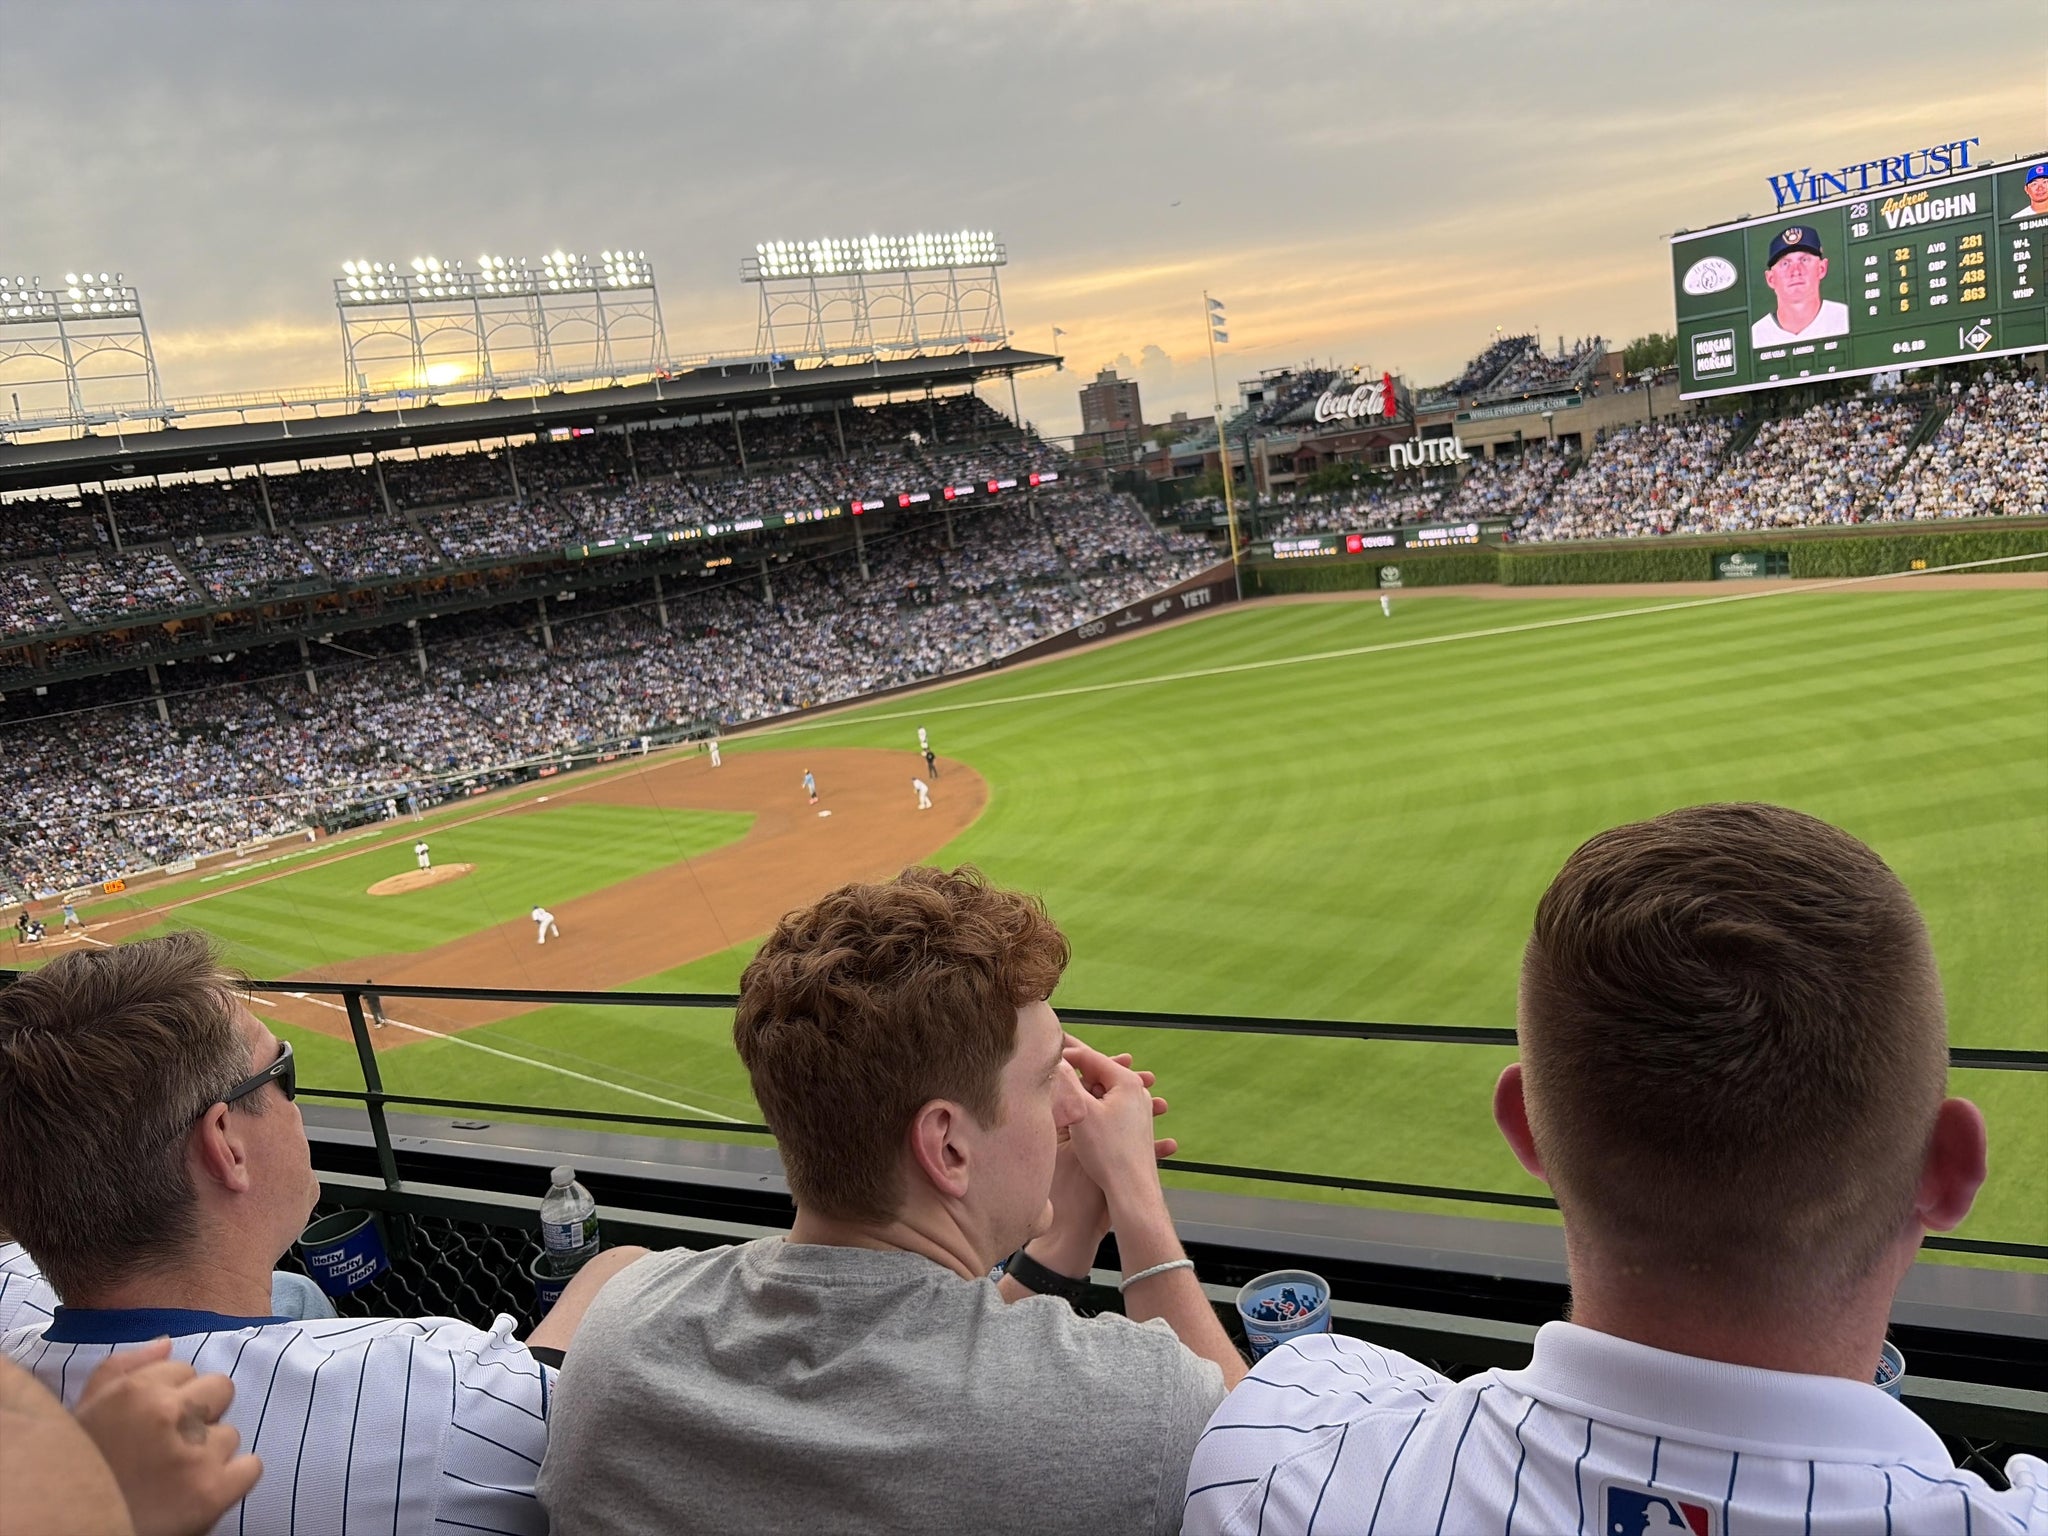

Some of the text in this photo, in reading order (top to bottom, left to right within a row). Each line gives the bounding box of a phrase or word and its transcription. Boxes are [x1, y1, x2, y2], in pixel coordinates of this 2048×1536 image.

[1766, 137, 1979, 207] WINTRUST
[1880, 190, 1929, 215] Andrew
[1850, 203, 1868, 219] 28
[1885, 193, 1976, 230] VAUGHN
[1851, 222, 1869, 238] 1B
[1927, 242, 1947, 255] AVG
[1959, 234, 1983, 250] .281
[2013, 238, 2030, 249] W-L
[1864, 255, 1878, 267] AB
[1895, 248, 1910, 262] 32
[1959, 252, 1985, 268] .425
[2013, 251, 2031, 262] ERA
[1899, 265, 1907, 278] 1
[1928, 260, 1947, 272] OBP
[2017, 263, 2028, 274] IP
[1865, 272, 1879, 283] HR
[1929, 277, 1947, 289] SLG
[1959, 269, 1985, 285] .438
[2019, 275, 2027, 285] K
[1899, 282, 1909, 295] 6
[1960, 287, 1986, 302] .863
[2012, 288, 2034, 300] WHIP
[1930, 294, 1948, 306] OPS
[1696, 337, 1732, 355] MORGAN
[1697, 354, 1733, 372] MORGAN
[1390, 436, 1472, 468] NÜTRL
[1361, 535, 1395, 548] TOYOTA
[1180, 588, 1211, 609] YETI
[313, 1252, 342, 1265] Hefty
[331, 1258, 361, 1276] Hefty
[350, 1262, 375, 1283] Hefty
